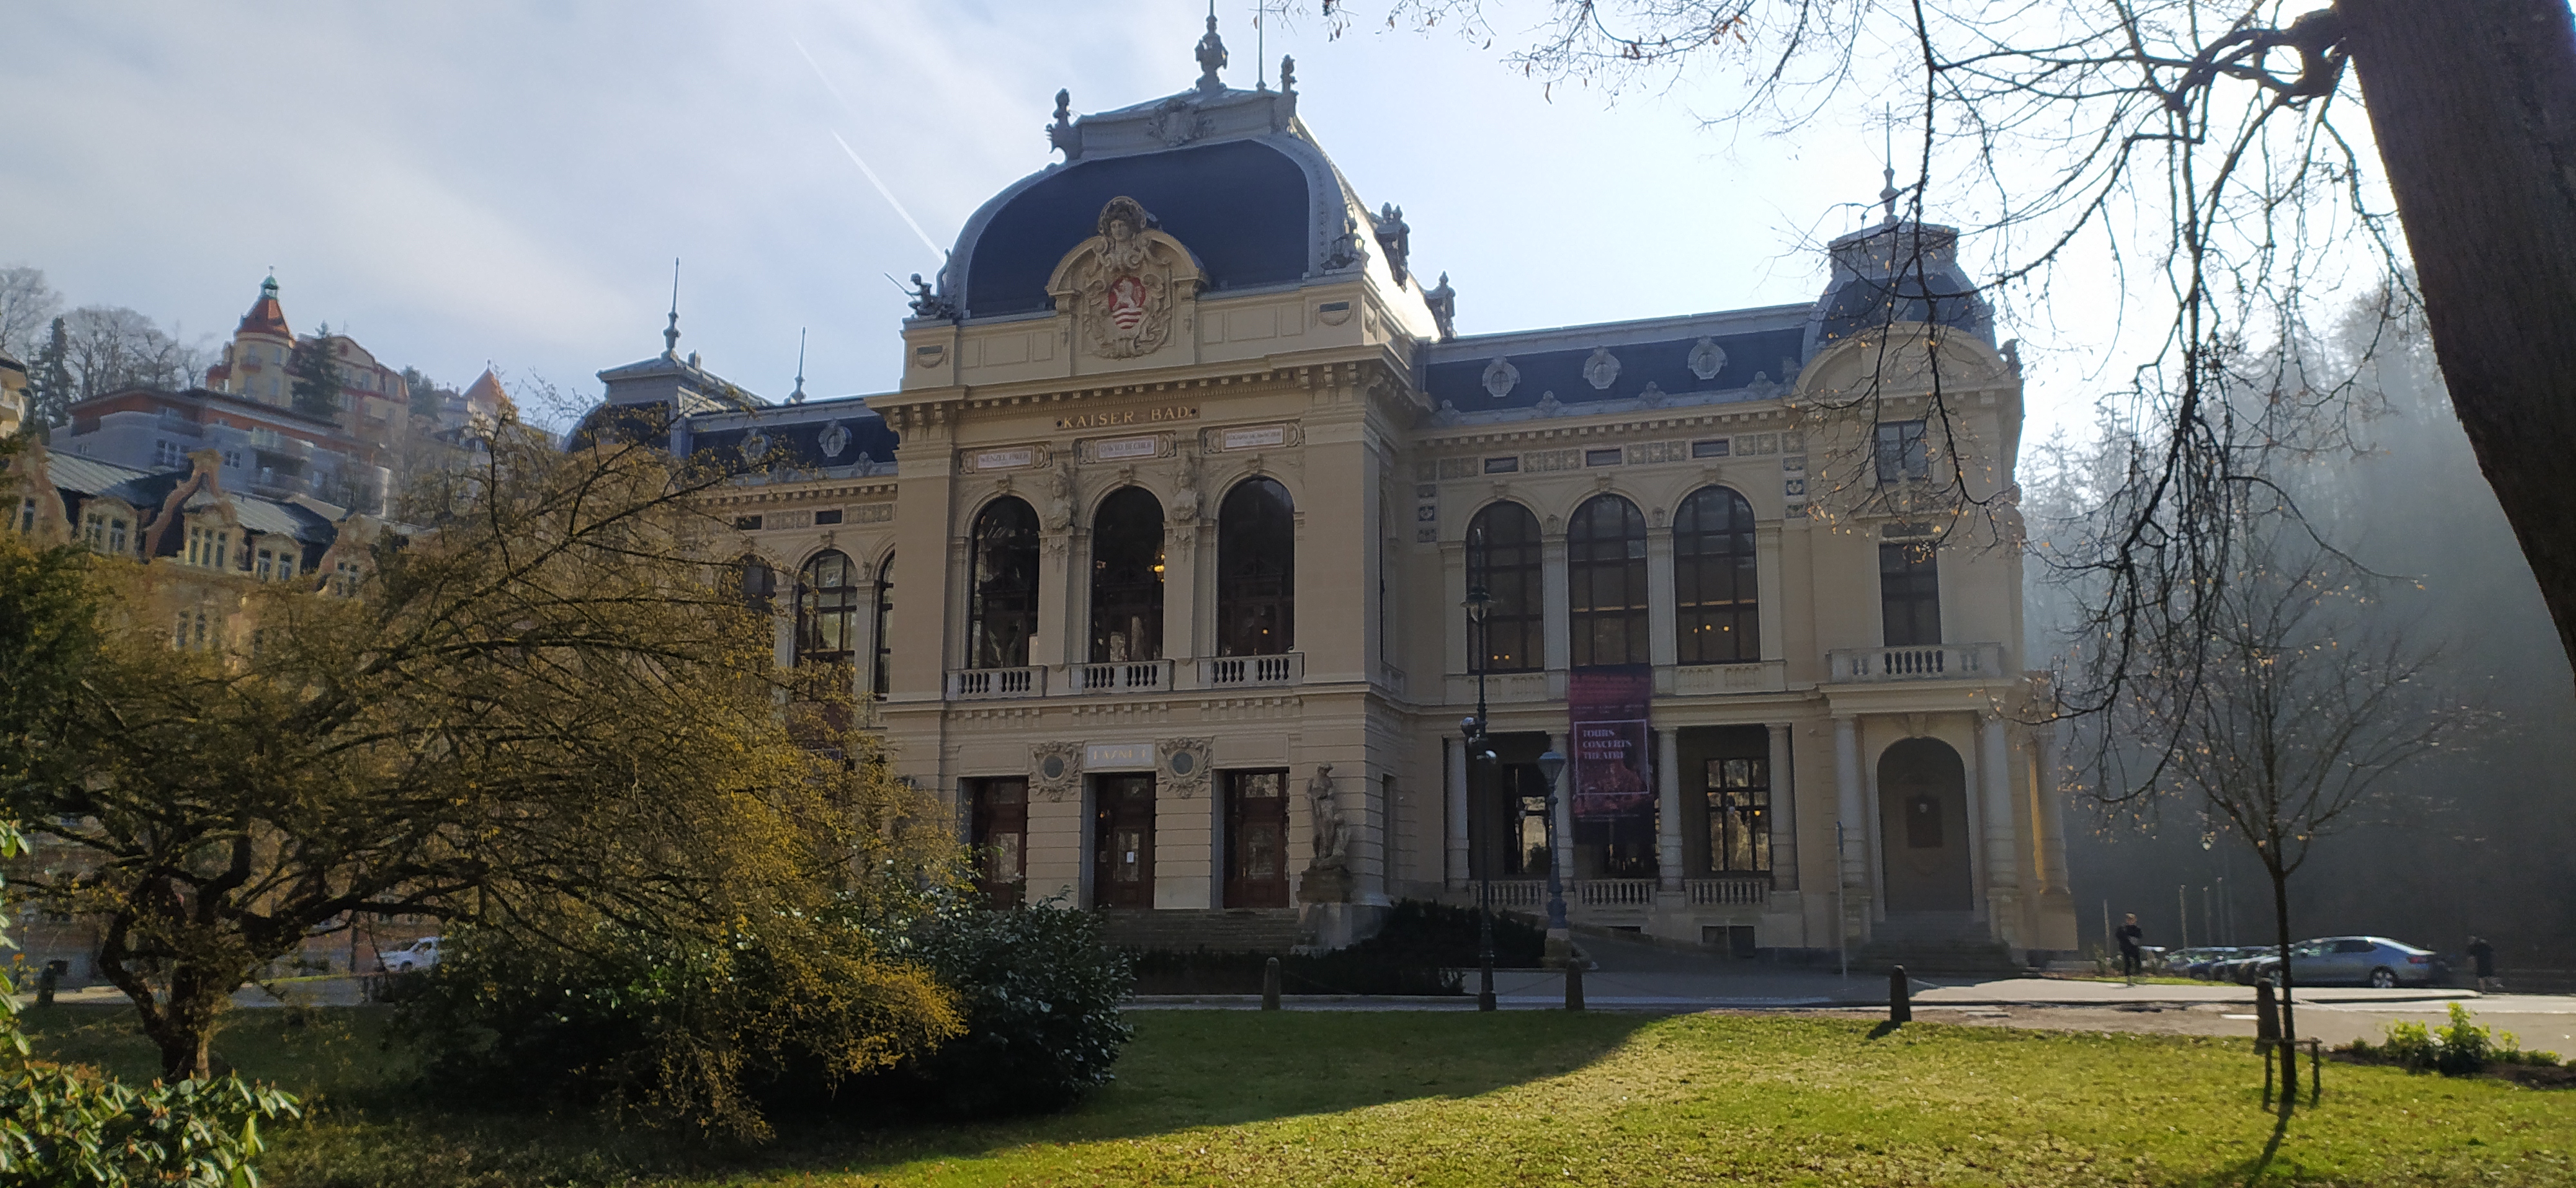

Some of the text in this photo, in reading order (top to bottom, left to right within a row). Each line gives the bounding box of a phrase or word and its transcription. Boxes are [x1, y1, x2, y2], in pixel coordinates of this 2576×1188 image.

[1064, 411, 1133, 428] KAISER
[1583, 740, 1632, 748] CONCERTS
[1582, 751, 1624, 760] THEATRE
